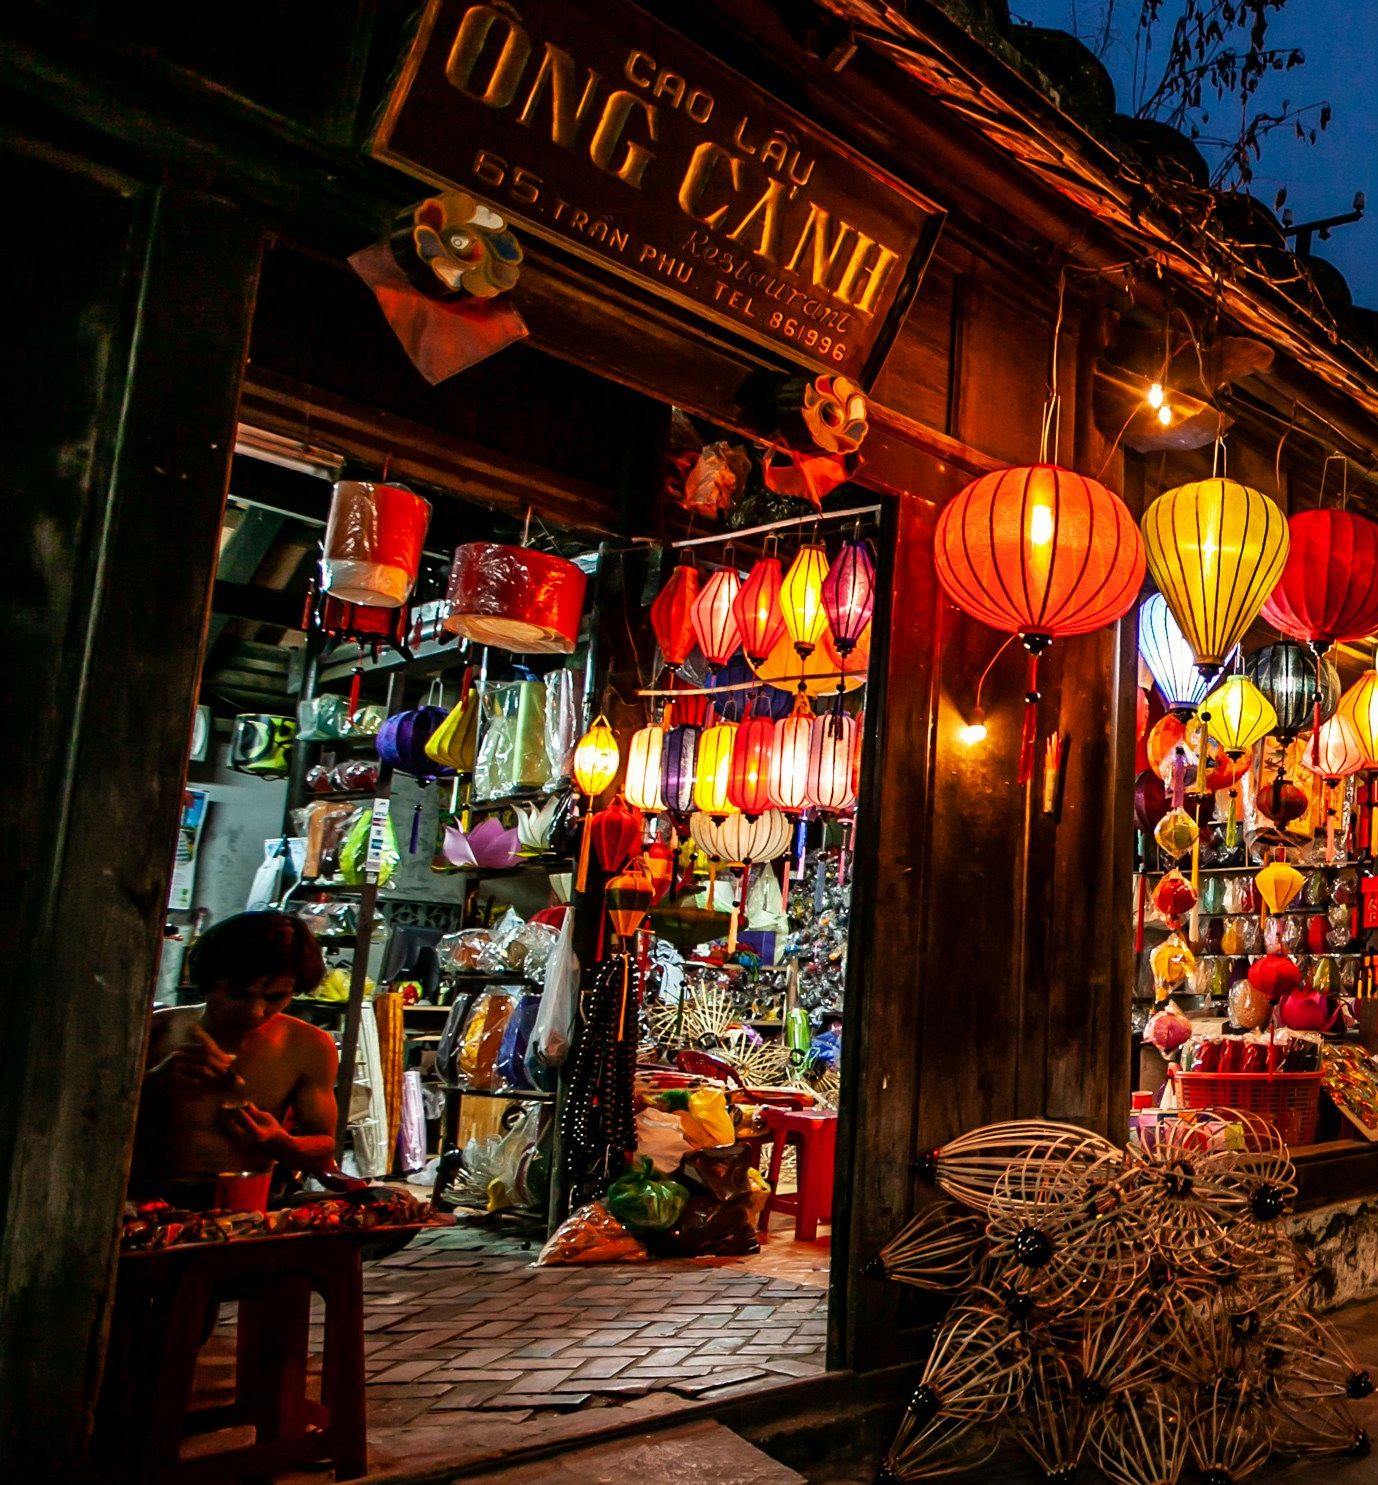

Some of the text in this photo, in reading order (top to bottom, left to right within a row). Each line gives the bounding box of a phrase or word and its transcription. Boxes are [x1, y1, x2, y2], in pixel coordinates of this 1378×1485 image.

[444, 0, 662, 191] ÔNG
[625, 50, 715, 124] CAO
[681, 230, 856, 334] Restaurant
[768, 310, 847, 362] 861996
